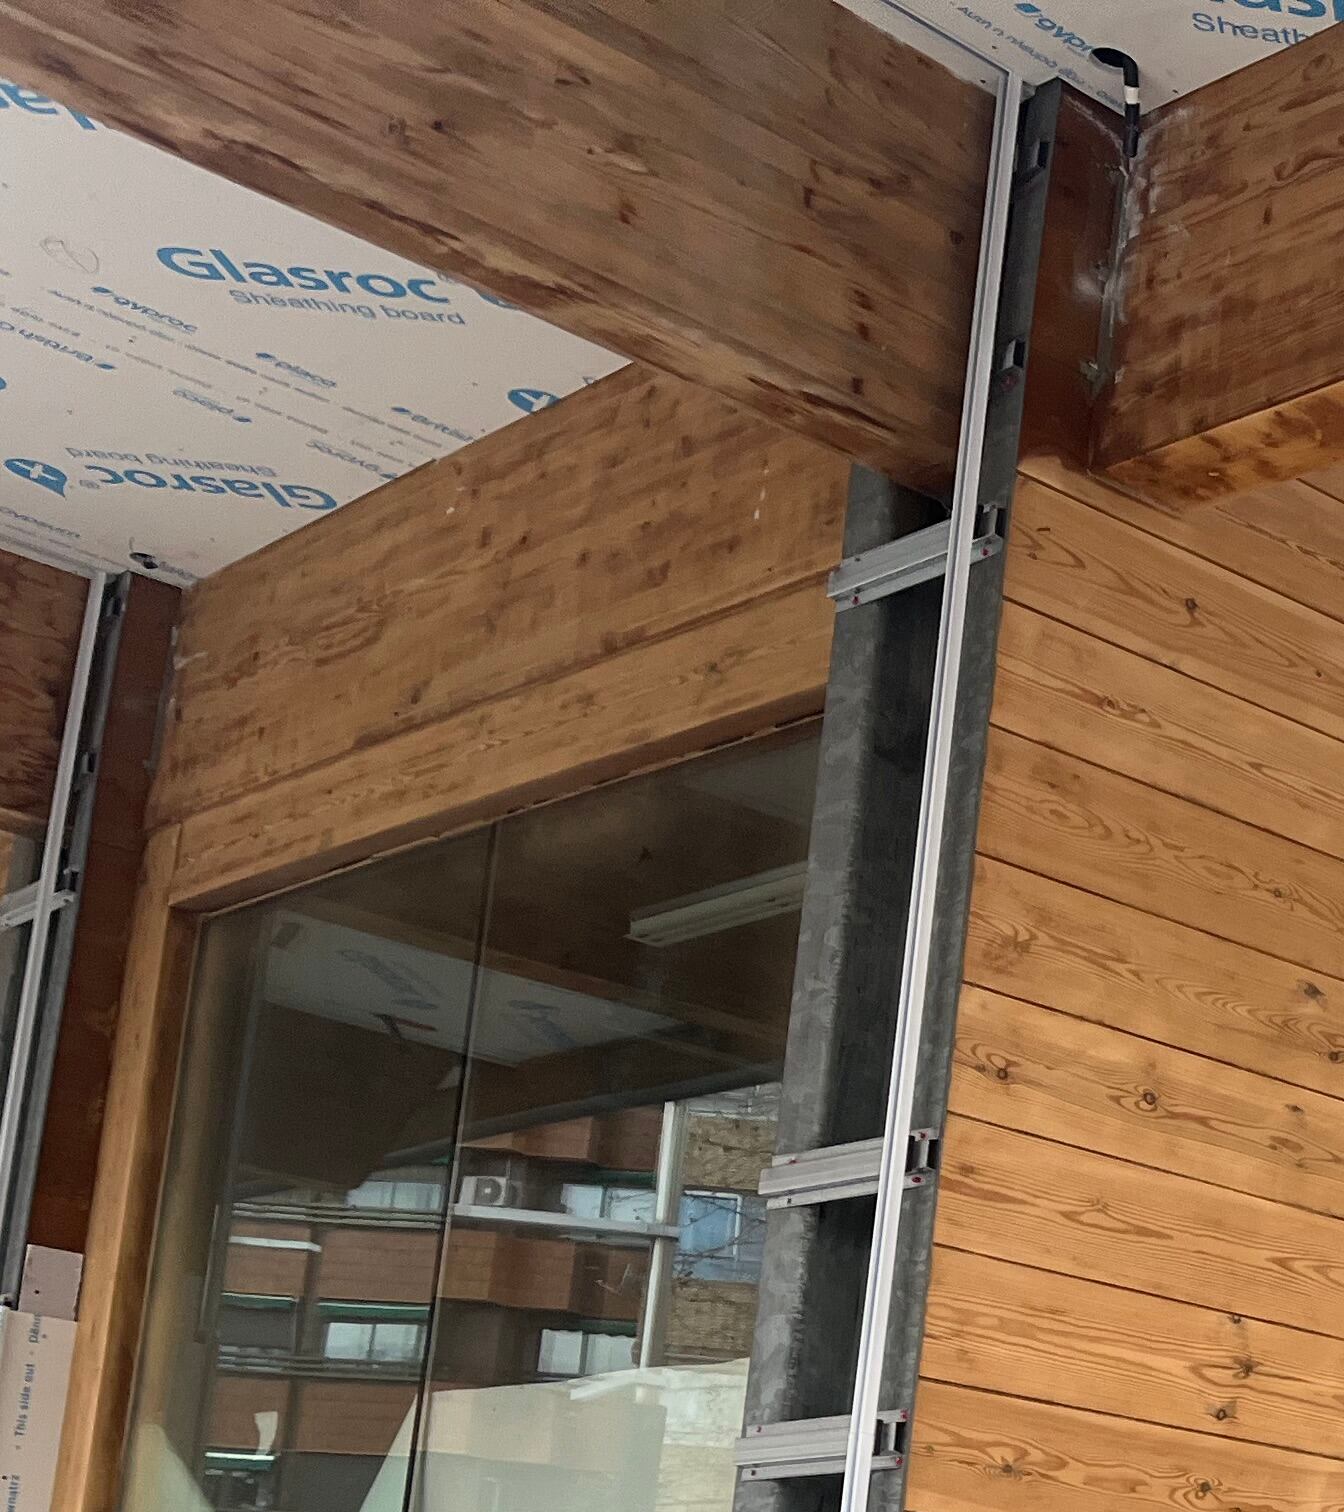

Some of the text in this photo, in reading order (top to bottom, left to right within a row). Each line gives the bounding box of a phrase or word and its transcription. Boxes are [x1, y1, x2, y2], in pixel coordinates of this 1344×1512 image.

[1037, 17, 1093, 56] gypr
[1192, 12, 1313, 45] Sheath
[156, 247, 449, 304] Glasroc
[113, 296, 198, 332] gyproc
[229, 290, 467, 325] Sheathing board
[65, 447, 278, 478] Sheathing board
[84, 465, 338, 510] Glasroc
[14, 1362, 35, 1438] This side out
